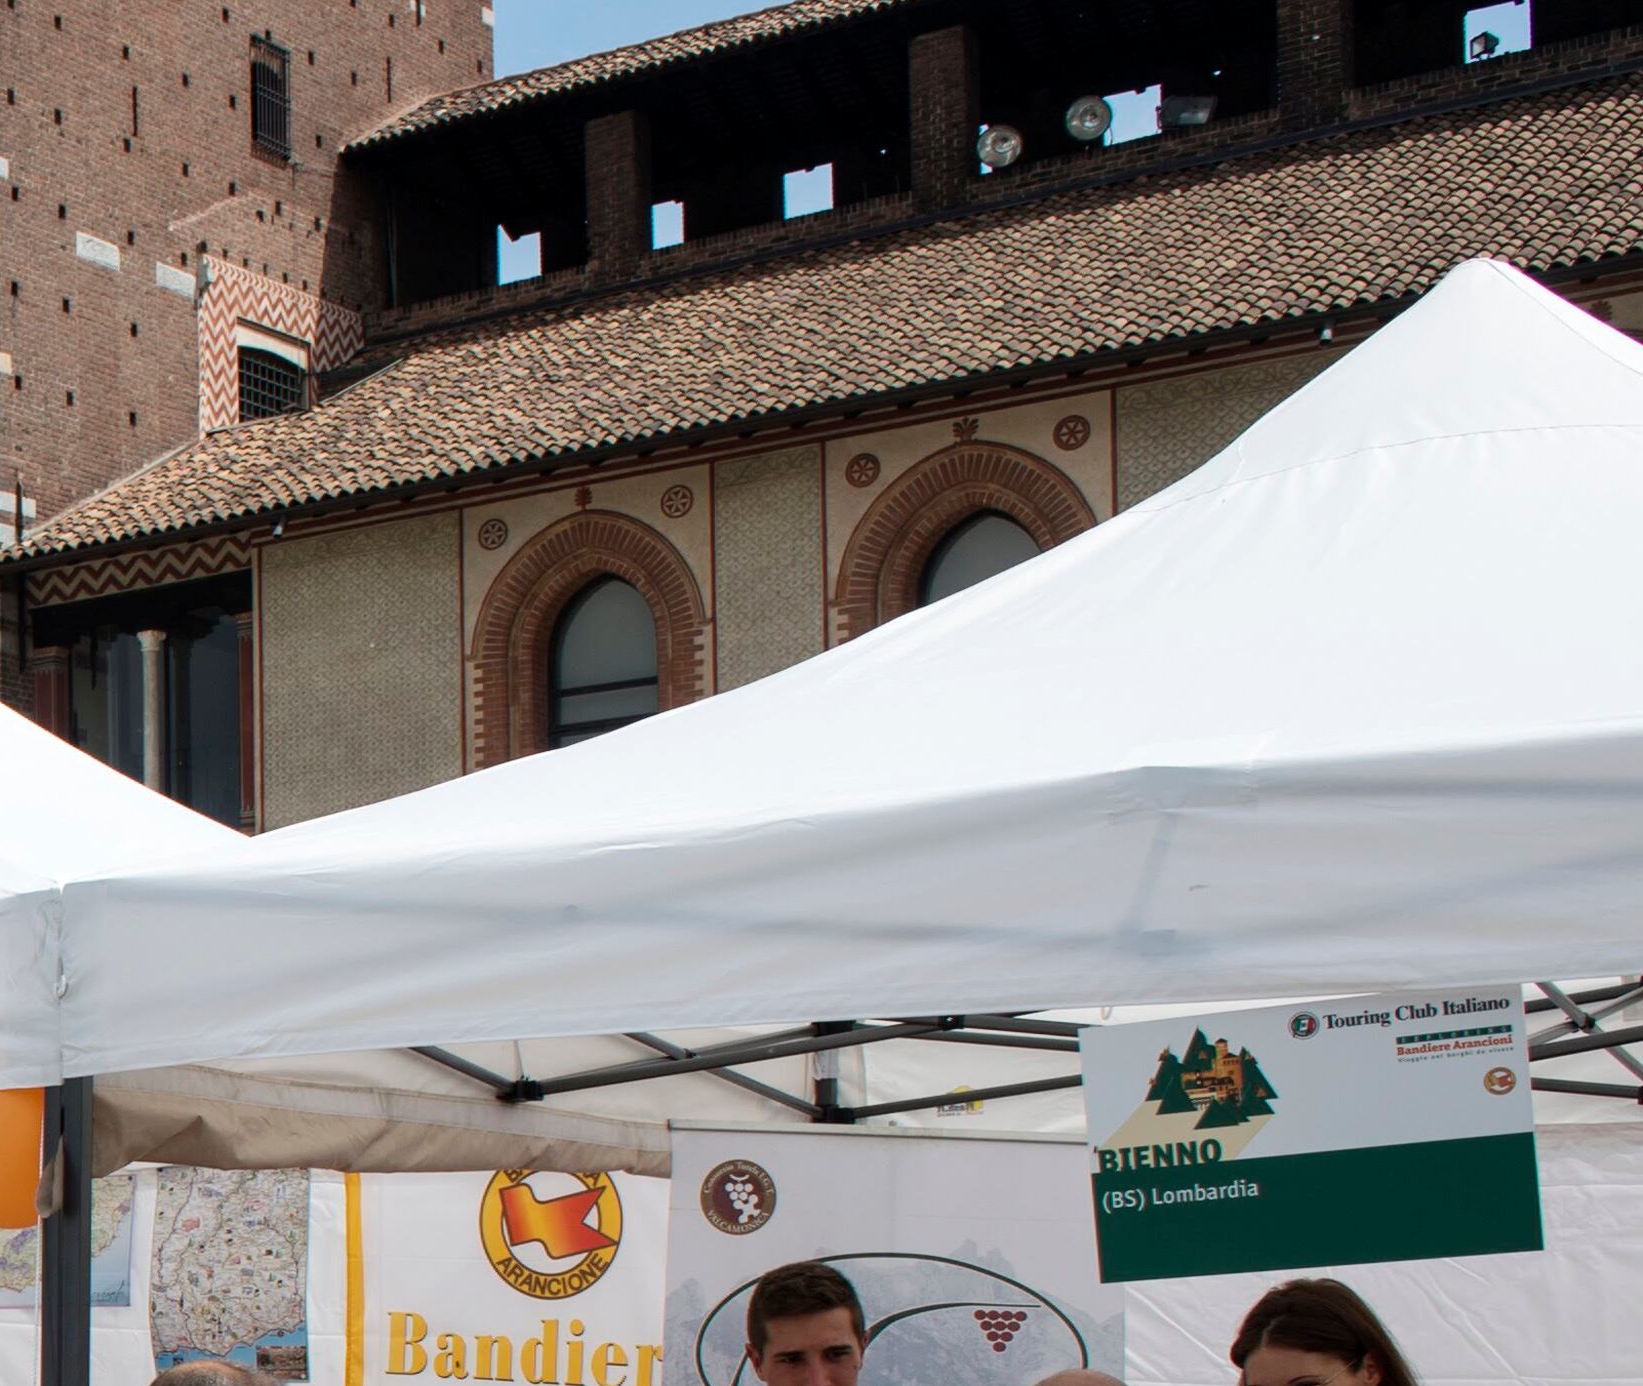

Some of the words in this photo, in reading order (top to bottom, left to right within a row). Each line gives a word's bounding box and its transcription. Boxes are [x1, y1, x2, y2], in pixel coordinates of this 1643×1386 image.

[1322, 1010, 1392, 1030] Touring
[1395, 1003, 1438, 1022] Club
[1442, 997, 1510, 1016] Italiano
[1397, 1041, 1450, 1056] Bandiere
[1453, 1034, 1513, 1050] Arancioni
[1097, 1138, 1222, 1173] BIENNO
[1102, 1188, 1146, 1214] (BS)
[1152, 1179, 1259, 1205] Lombardia
[707, 1208, 772, 1233] VALCAMONICA
[496, 1252, 609, 1298] ARANCIONE
